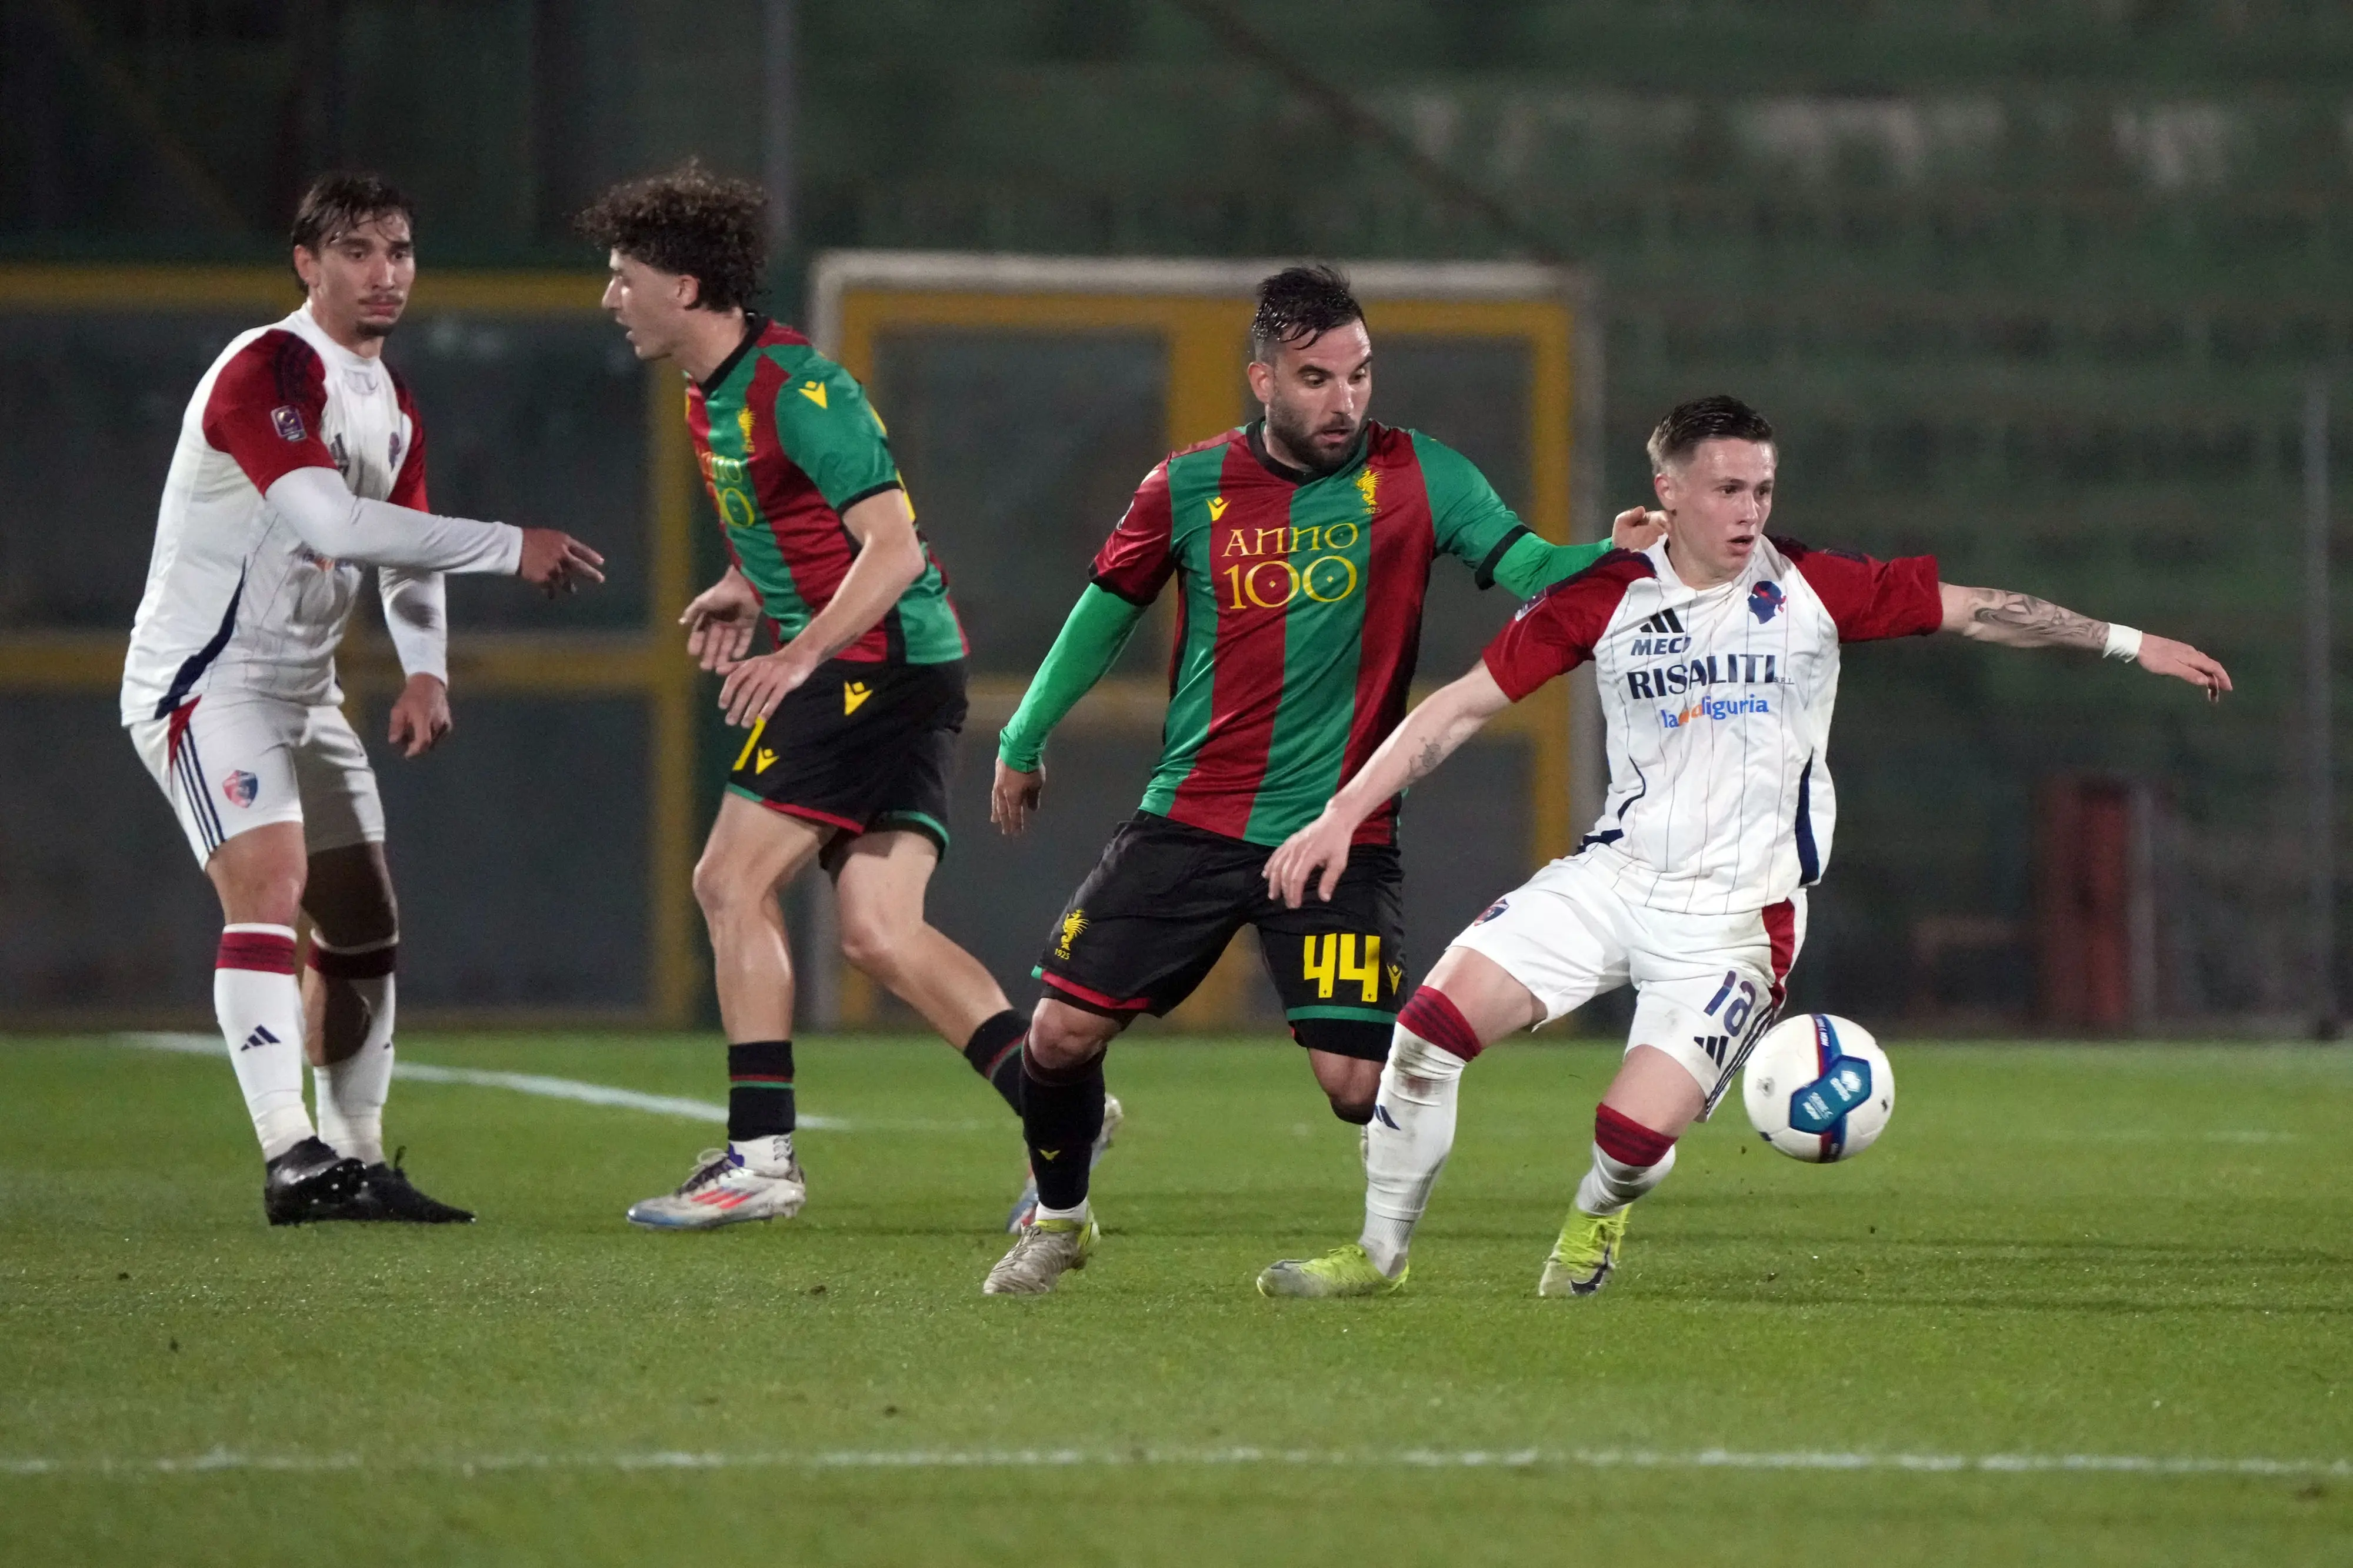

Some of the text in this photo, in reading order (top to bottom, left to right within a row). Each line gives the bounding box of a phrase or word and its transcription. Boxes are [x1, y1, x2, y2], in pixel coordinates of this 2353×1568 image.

[1223, 555, 1358, 609] 100
[1627, 653, 1776, 700] RISALITI
[1054, 948, 1071, 960] 1925
[1304, 932, 1381, 1002] 44
